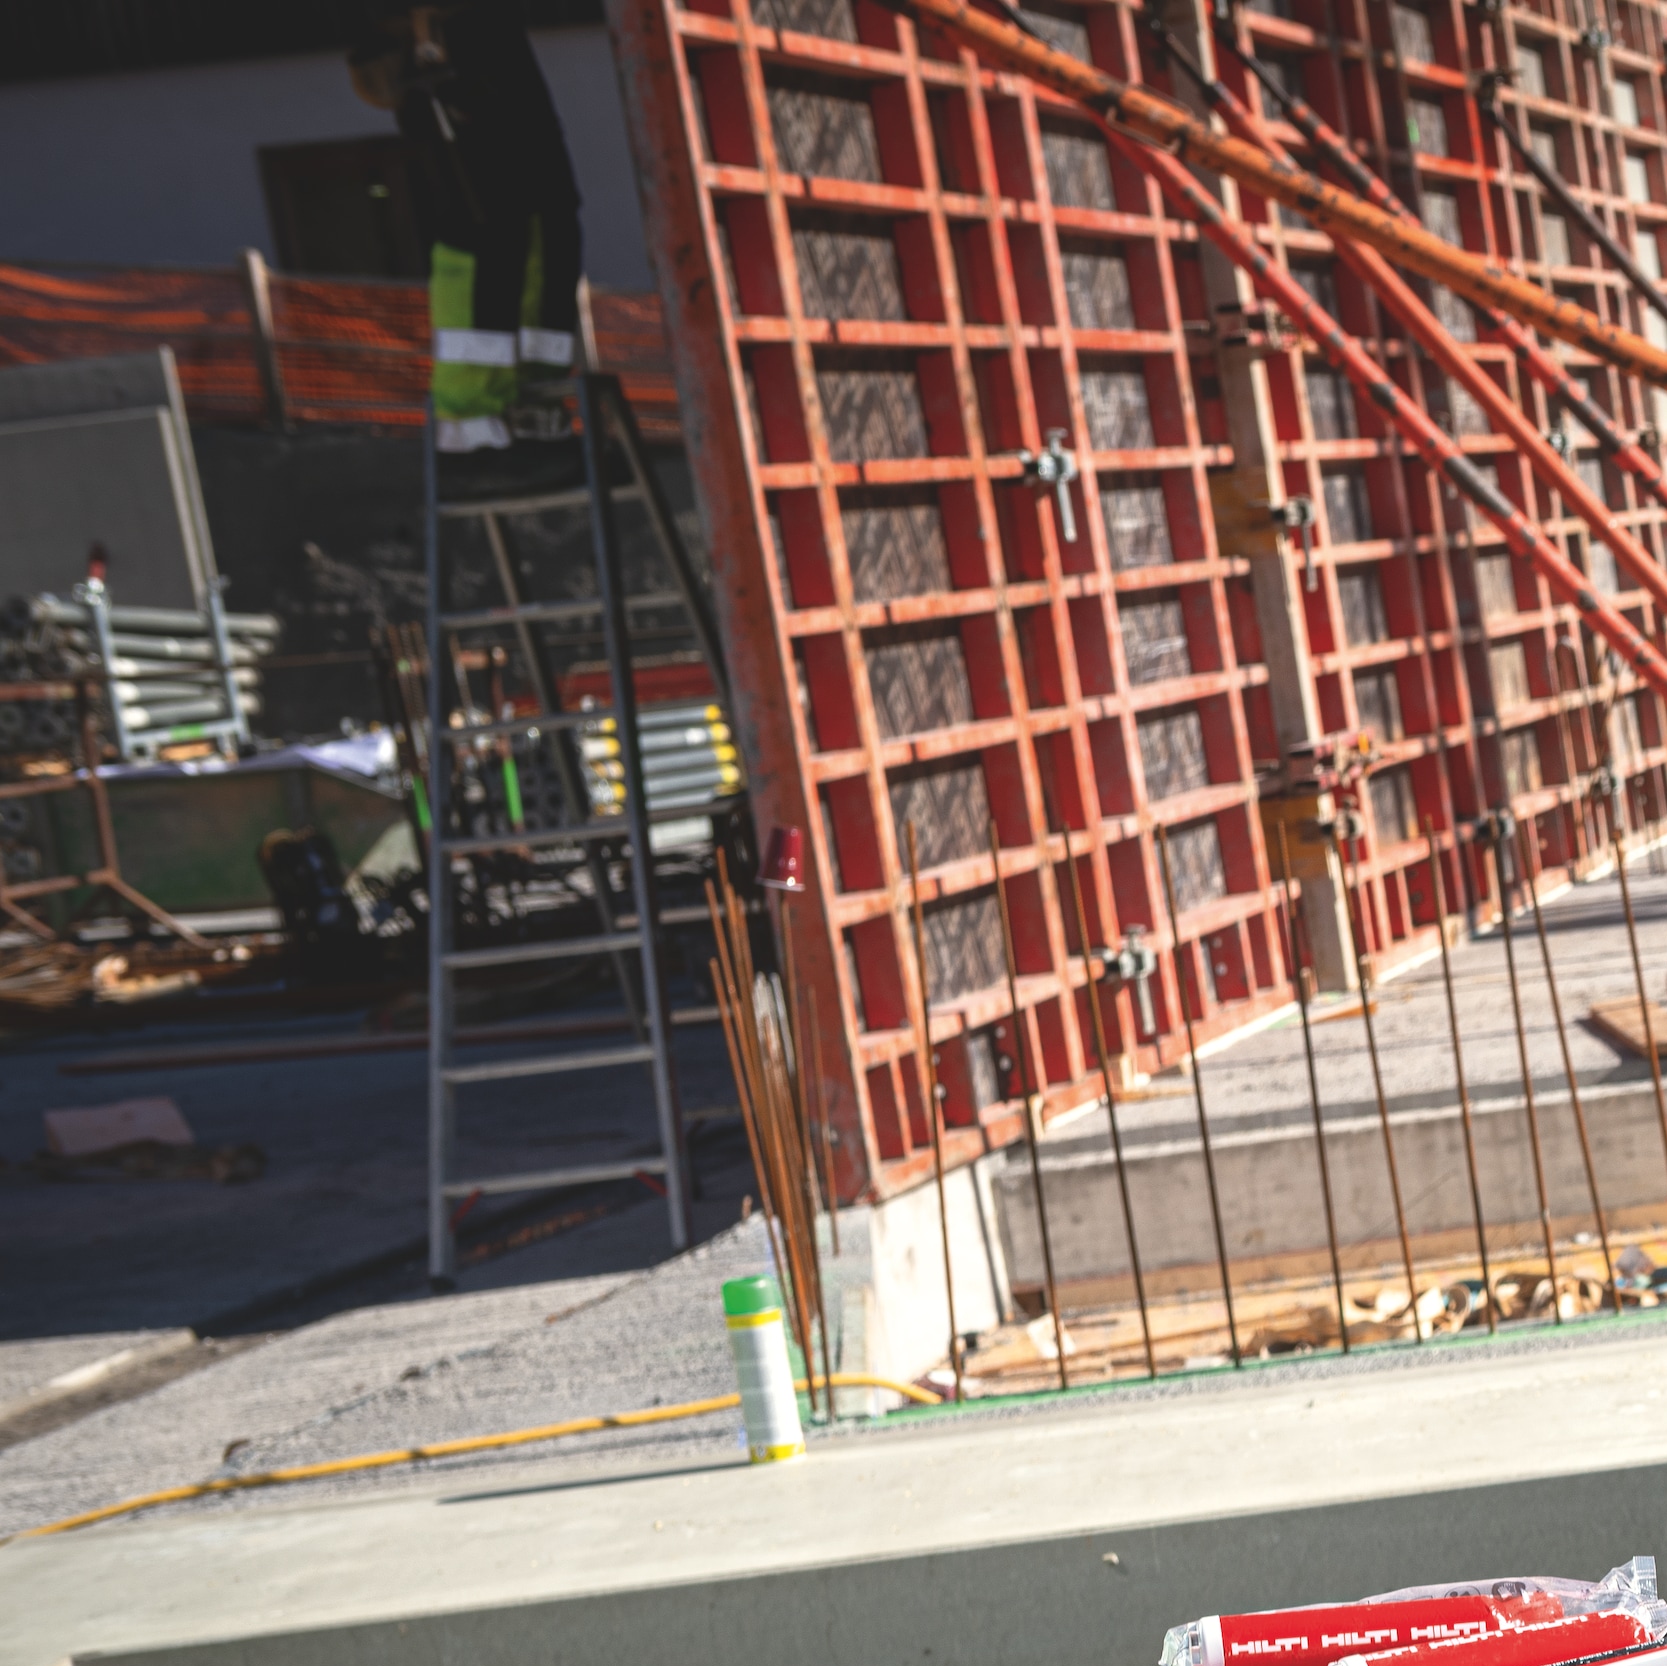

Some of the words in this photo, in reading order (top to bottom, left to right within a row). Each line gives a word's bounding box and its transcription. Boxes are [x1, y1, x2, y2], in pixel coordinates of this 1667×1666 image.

[1321, 1629, 1398, 1648] HILTI
[1410, 1621, 1486, 1640] HILTI
[1231, 1636, 1308, 1656] HILTI
